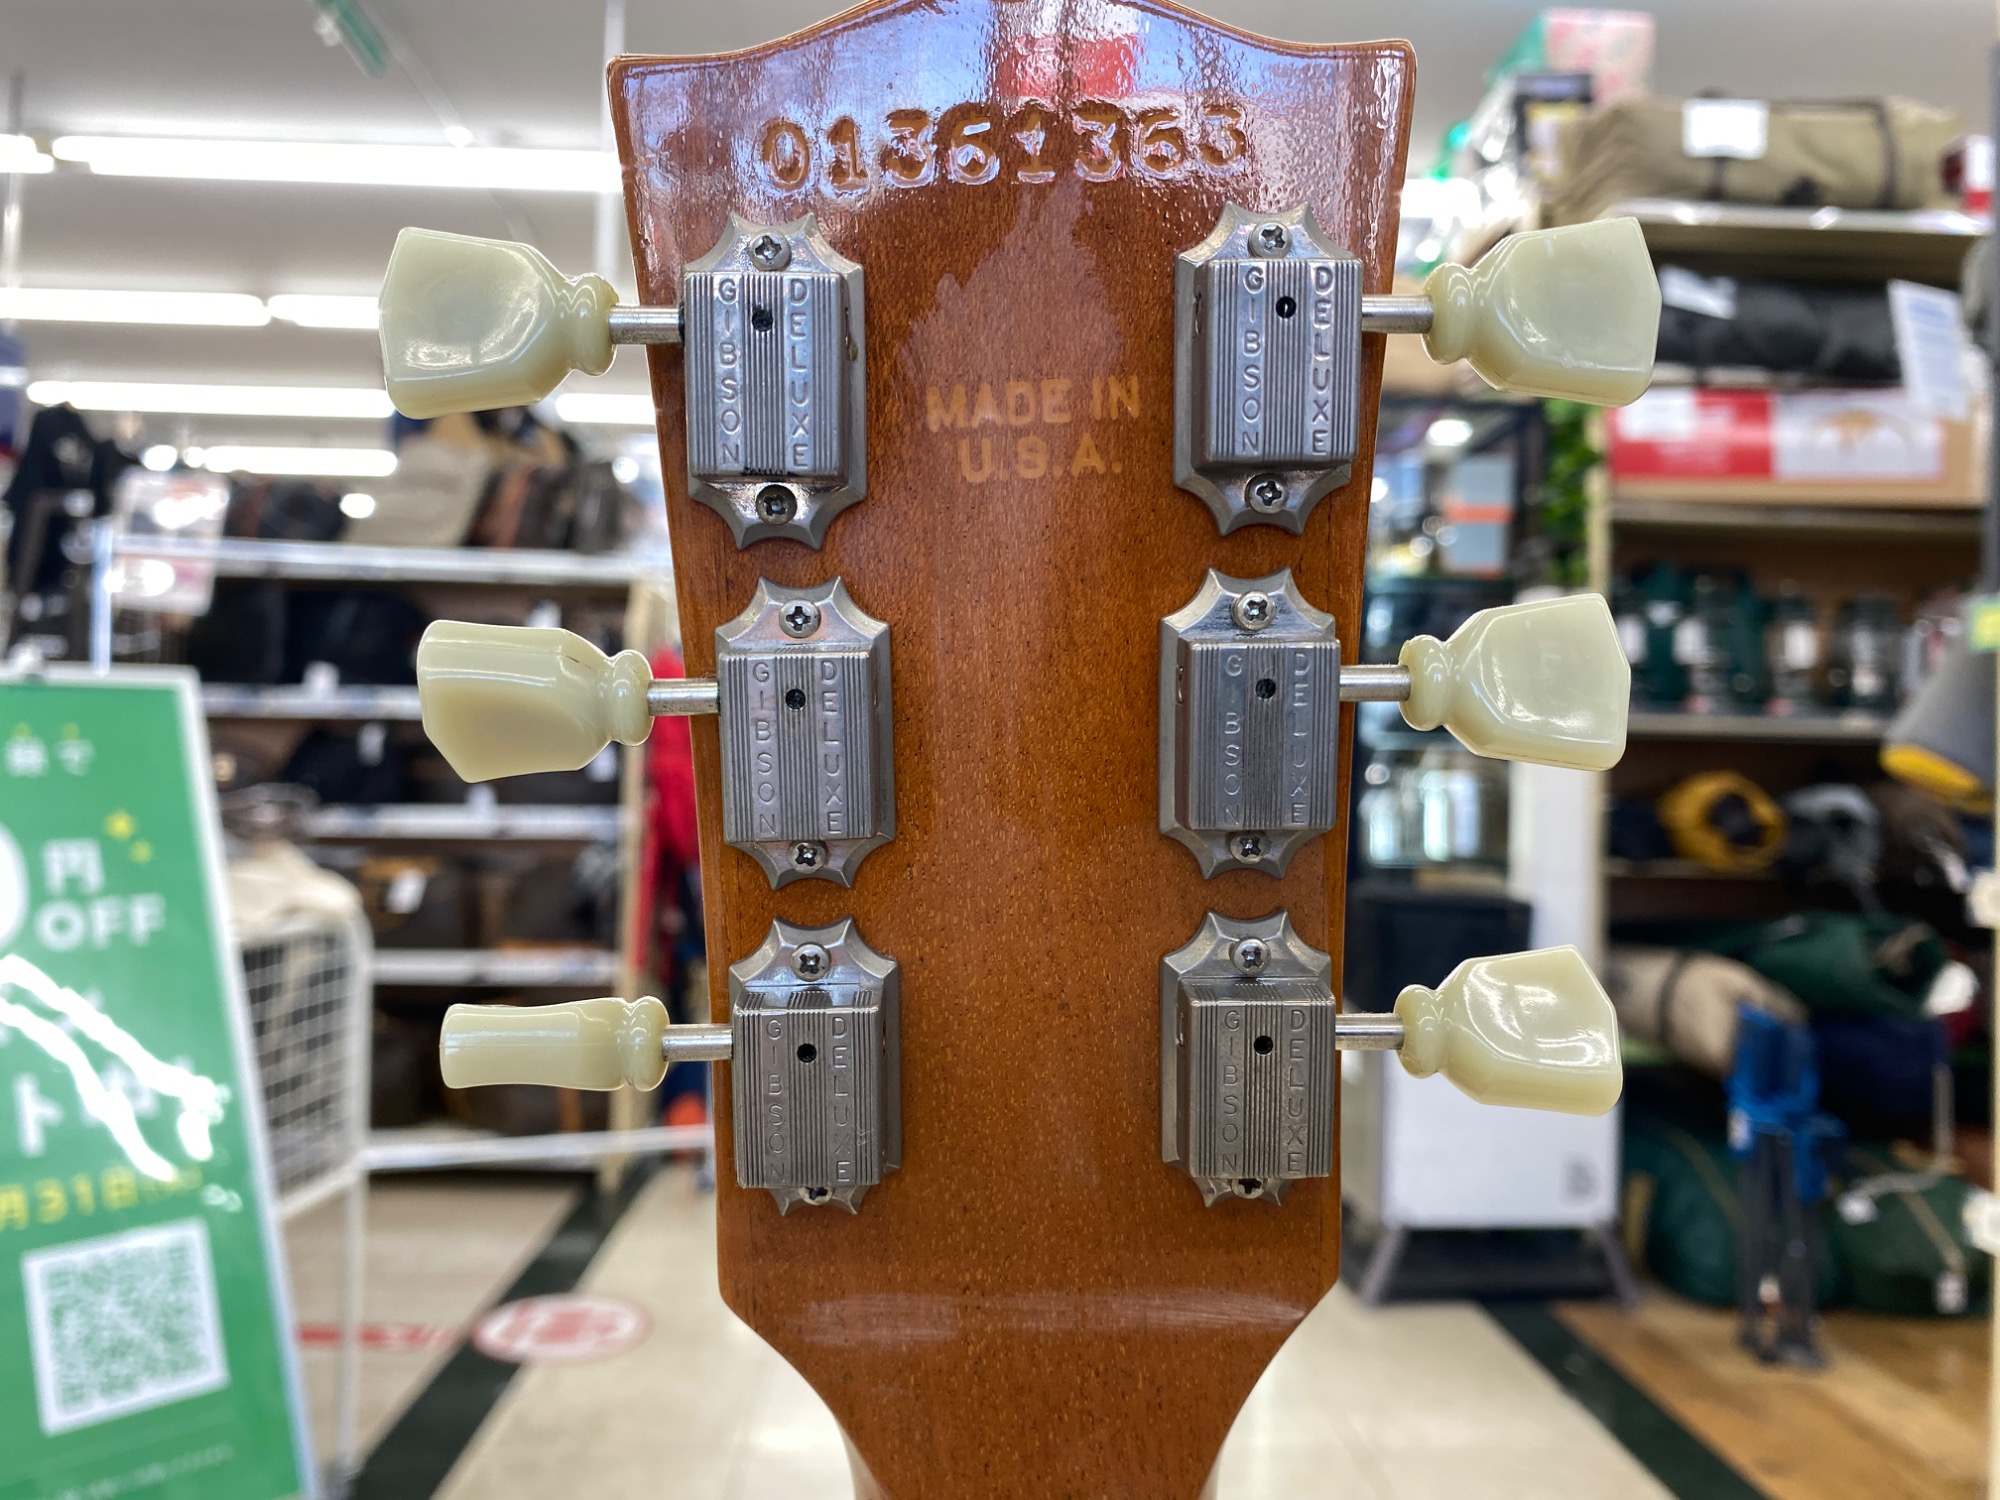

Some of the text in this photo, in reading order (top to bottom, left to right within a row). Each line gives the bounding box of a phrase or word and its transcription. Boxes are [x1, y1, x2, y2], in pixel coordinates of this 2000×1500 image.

[760, 100, 1248, 194] 01361363
[716, 278, 741, 466] GIBSON
[789, 278, 810, 469] DELUXE
[925, 374, 1141, 433] MADE IN
[1242, 266, 1265, 456] GIBSON
[1311, 266, 1334, 457] DELUXE
[957, 431, 1124, 484] U.S.A.
[752, 661, 776, 836] GIBSON
[820, 660, 843, 835] DELUXE
[34, 891, 167, 953] OFF
[765, 1018, 789, 1184] GIBSON
[831, 1016, 852, 1184] DELUXE
[1221, 1010, 1242, 1172] GIBSON
[1286, 1010, 1306, 1173] DELUXE
